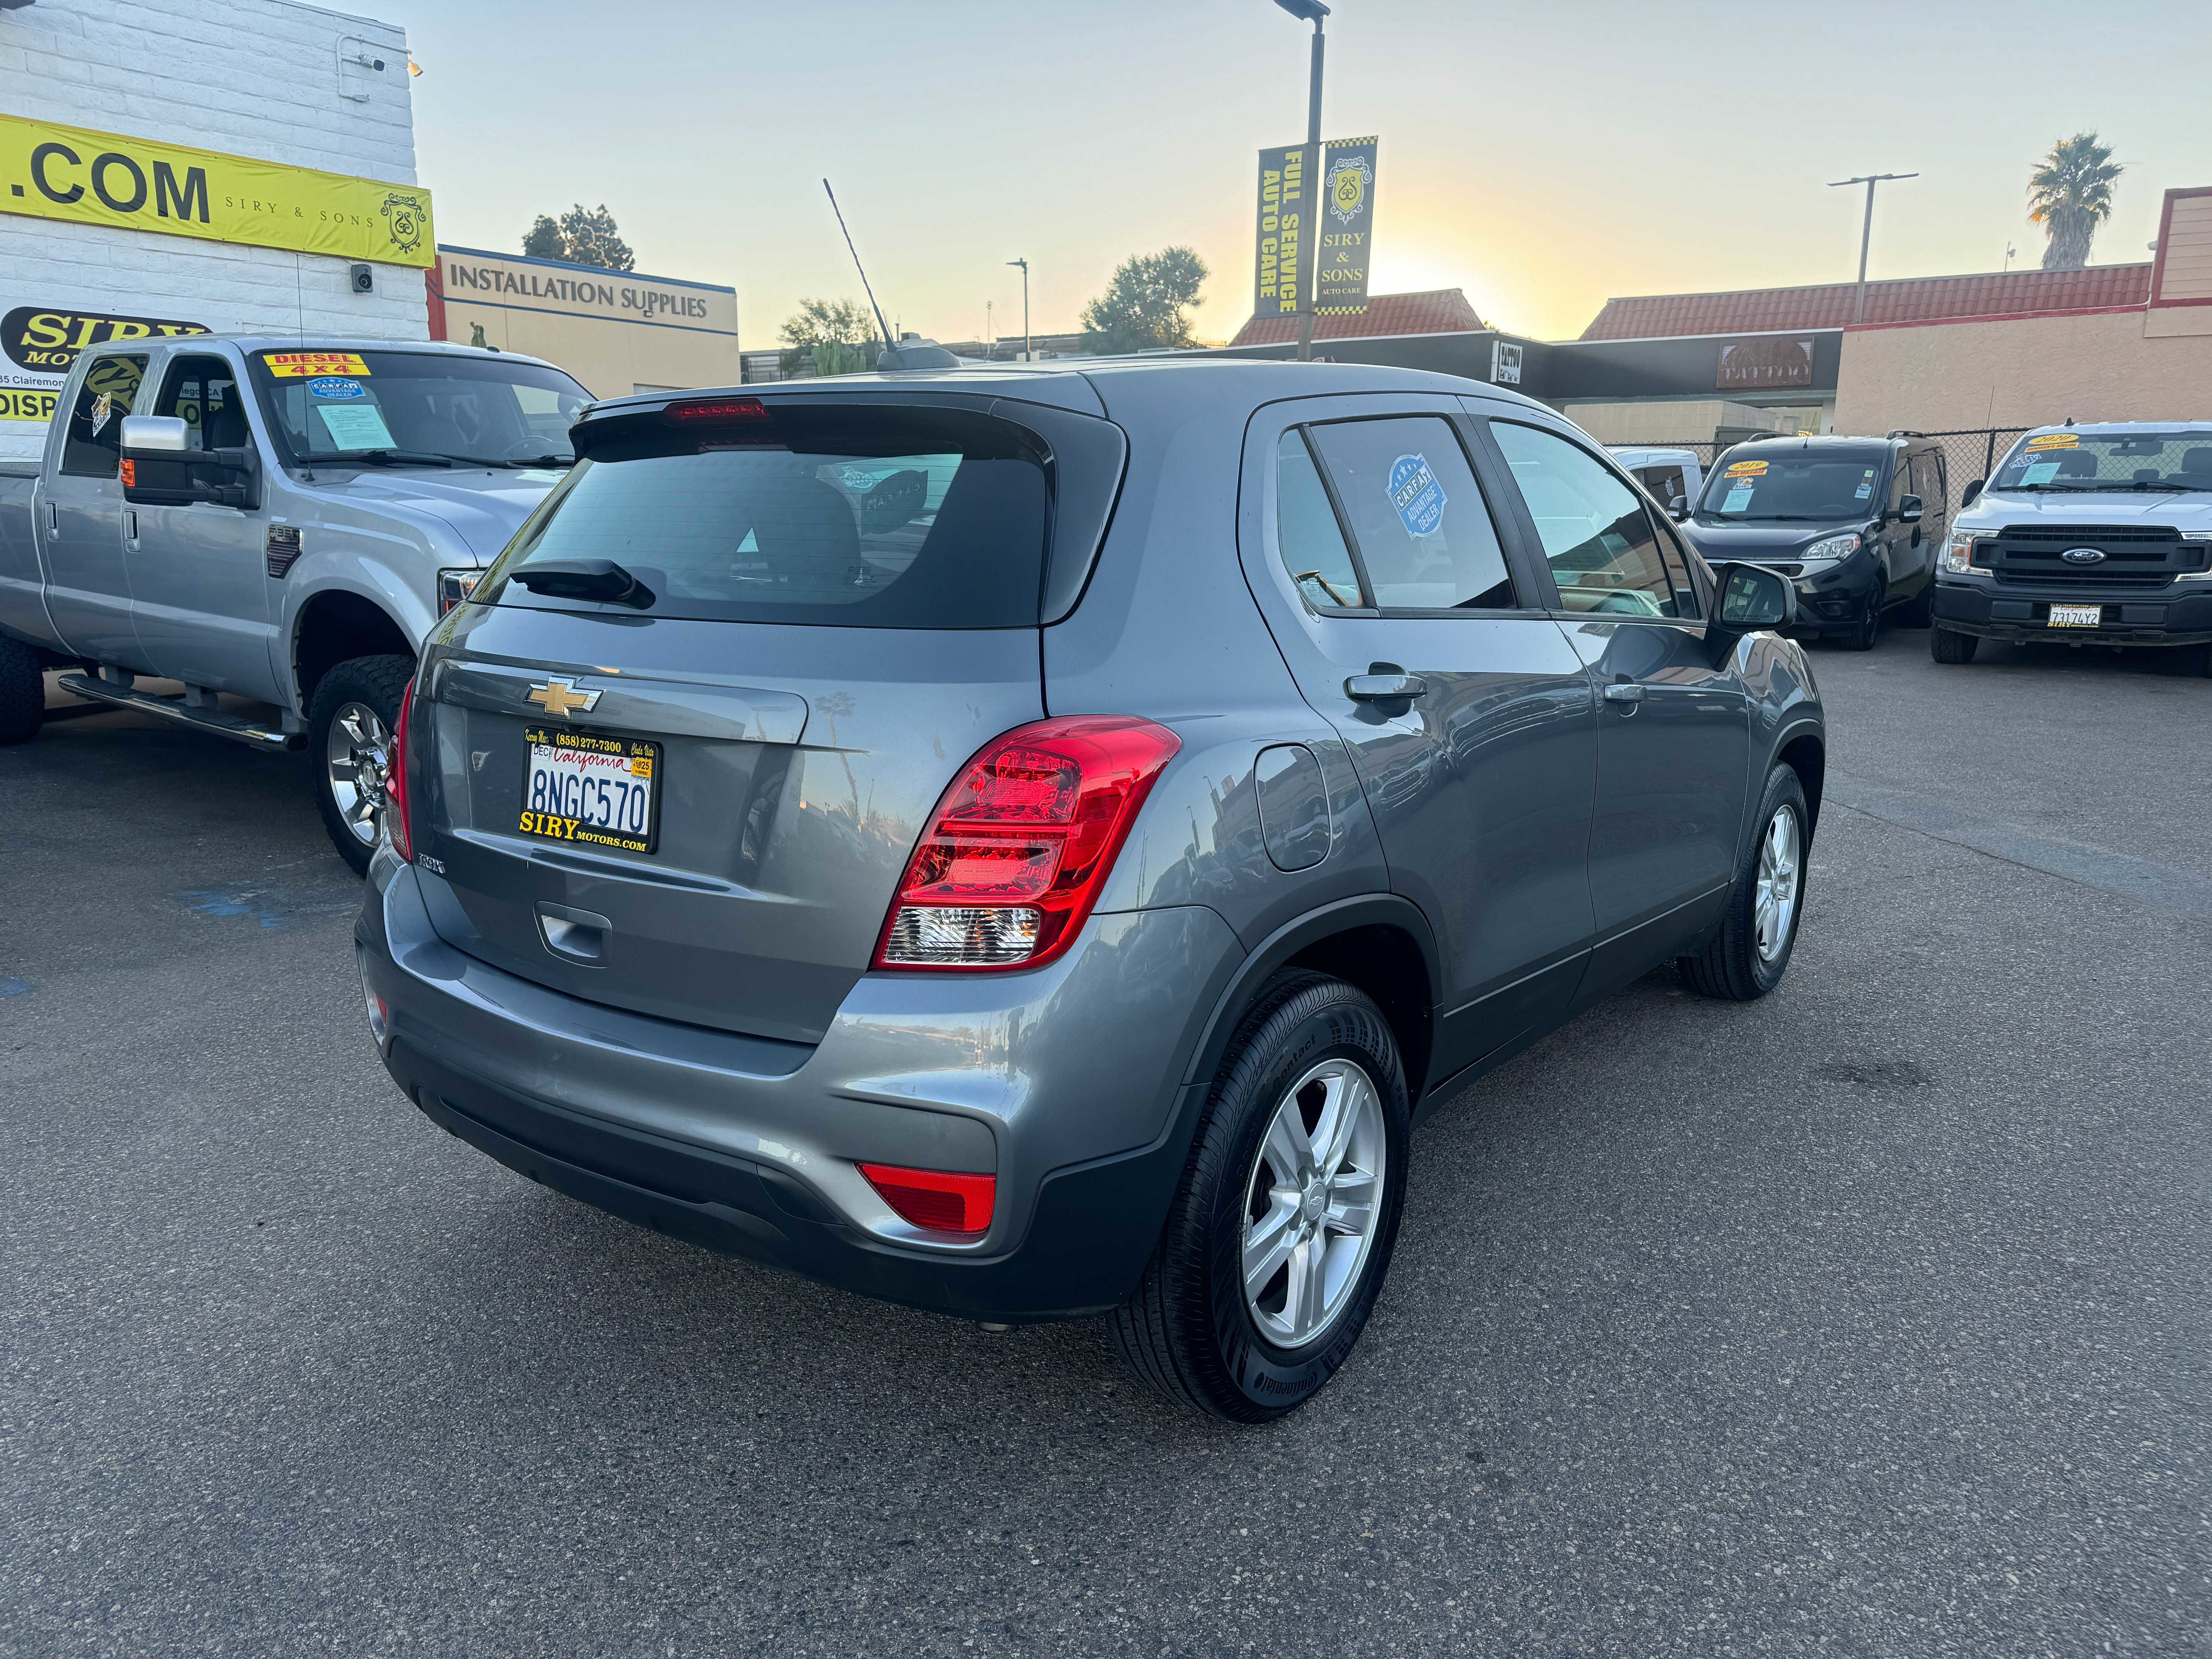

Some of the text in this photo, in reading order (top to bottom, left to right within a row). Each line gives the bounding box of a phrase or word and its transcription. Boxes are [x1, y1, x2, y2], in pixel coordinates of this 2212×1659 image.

[11, 142, 210, 223] .COM
[226, 196, 373, 228] SIRY & SONS
[1260, 170, 1280, 298] AUTO CARE
[1279, 151, 1303, 313] FULL SERVICE
[1324, 233, 1364, 247] SIRY
[1336, 252, 1349, 263] &
[1322, 268, 1363, 282] SONS
[450, 264, 707, 318] INSTALLATION SUPPLIES
[274, 354, 356, 363] DIESEL
[12, 376, 64, 386] Clairemon
[0, 394, 57, 417] DISP
[1396, 469, 1431, 507] CARFAX
[1407, 486, 1437, 523] ADVANTAGE
[1418, 503, 1440, 531] DEALER
[2072, 551, 2094, 560] Ford
[2052, 612, 2097, 625] 73174Y2
[534, 746, 549, 757] DEC
[556, 733, 622, 753] (858) 277-7300
[554, 747, 632, 773] California
[641, 761, 649, 770] 25
[532, 769, 646, 833] 8NGC570
[519, 811, 647, 852] SIRY MOTORS.COM
